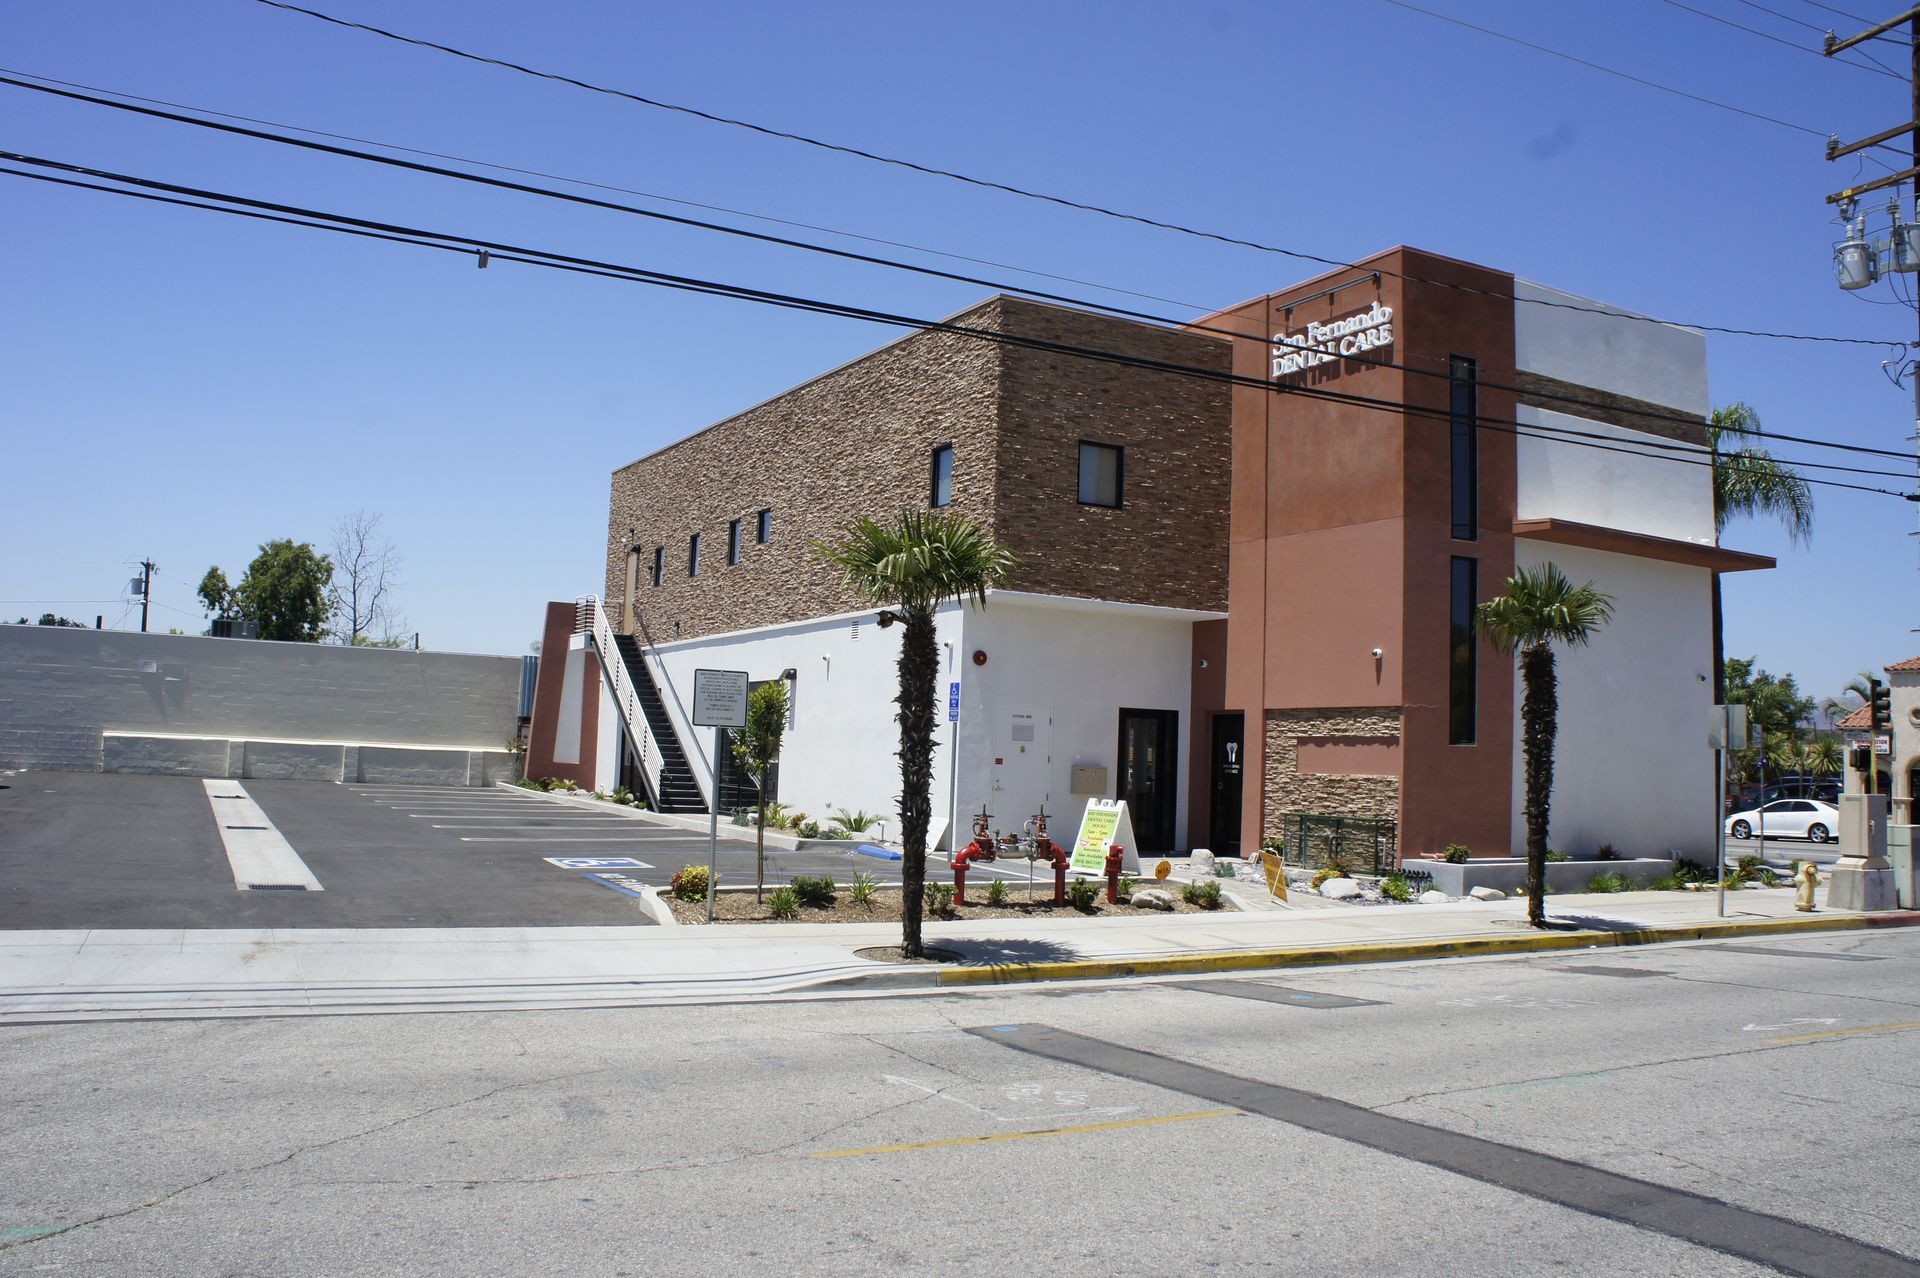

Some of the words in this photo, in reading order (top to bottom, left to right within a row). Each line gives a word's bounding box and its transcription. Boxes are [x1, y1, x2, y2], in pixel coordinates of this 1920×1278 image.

[1272, 341, 1340, 377] DENTAL
[1340, 324, 1394, 356] CARE
[1273, 333, 1306, 356] San
[1307, 301, 1393, 346] Fernando
